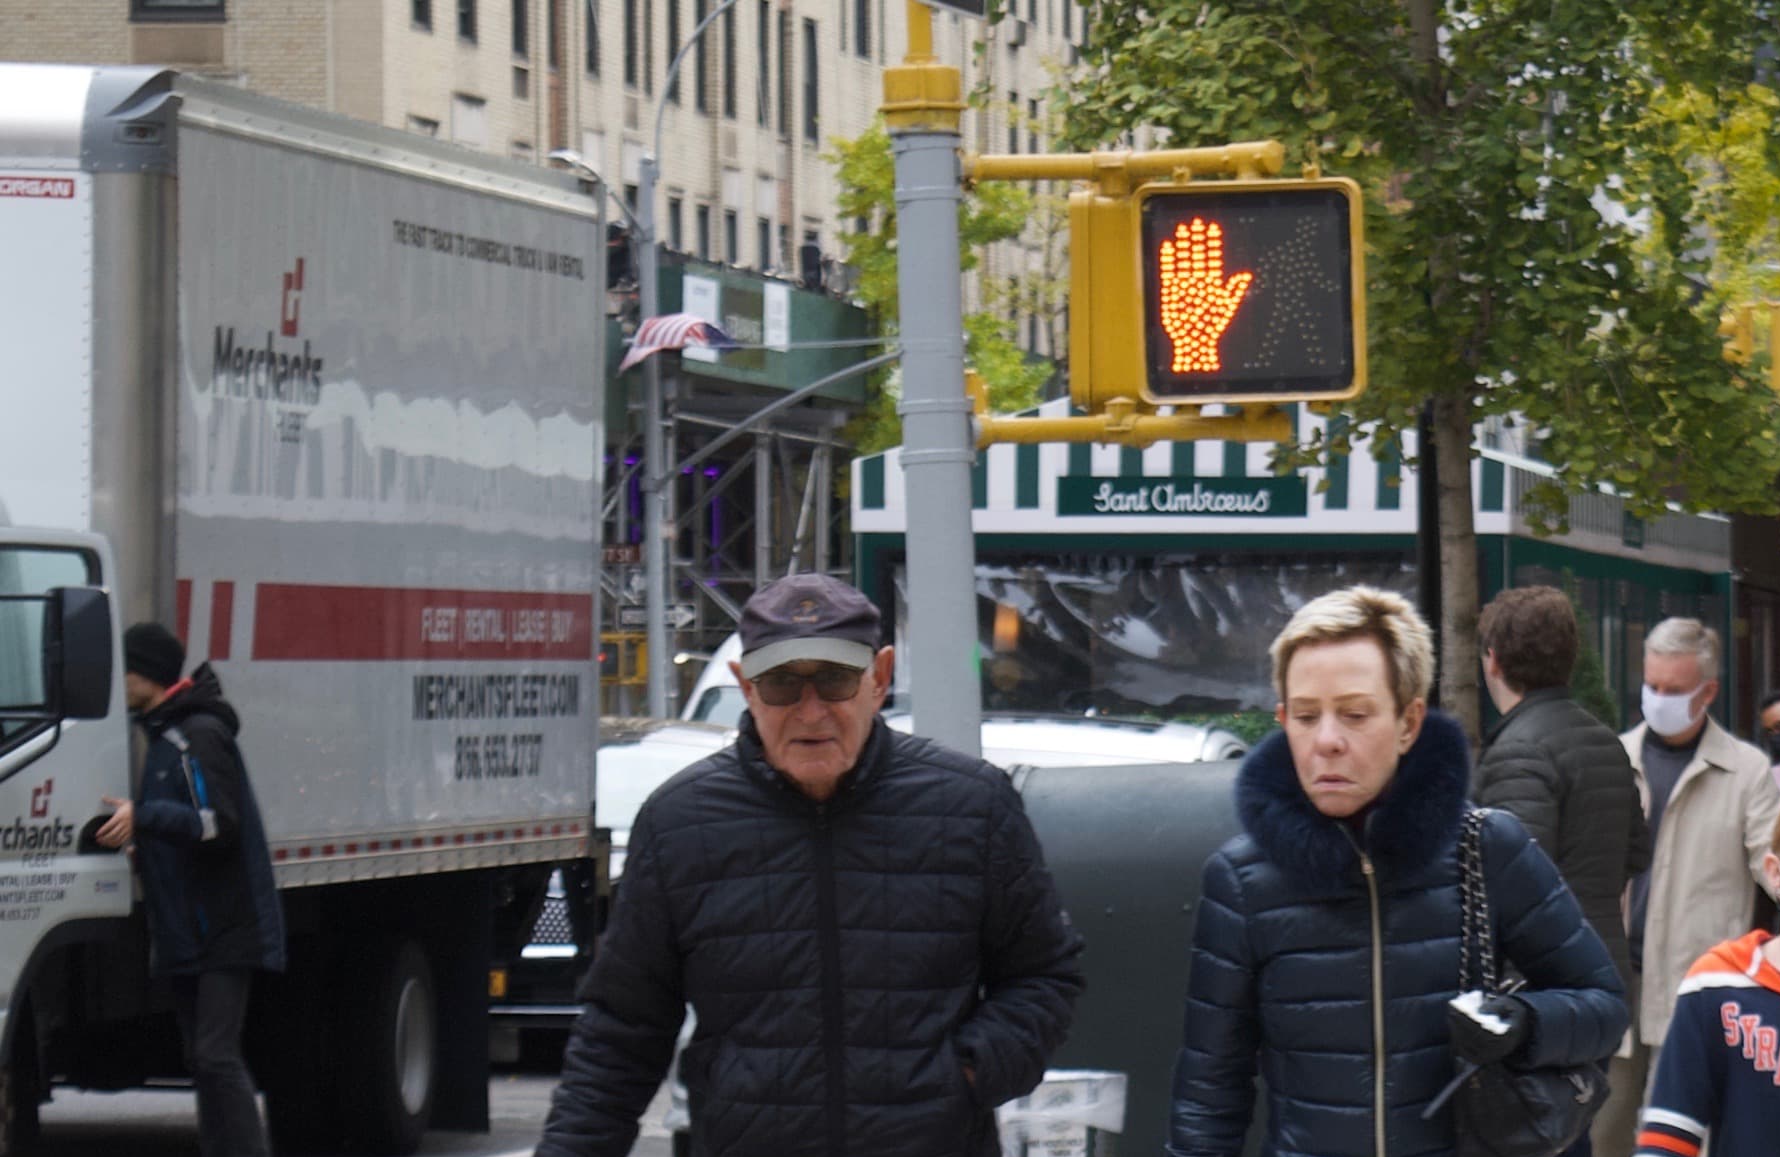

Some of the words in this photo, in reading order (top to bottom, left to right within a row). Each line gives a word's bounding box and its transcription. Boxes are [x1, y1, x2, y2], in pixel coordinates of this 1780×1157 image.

[212, 324, 325, 406] Merchants
[1093, 481, 1151, 512] Sant
[422, 608, 457, 642] FLEET
[463, 608, 506, 642] RENTAL
[512, 609, 545, 642] LEASE
[551, 610, 574, 642] BUY
[412, 674, 579, 721] MERCHANTSFLEET.COM
[0, 816, 74, 849] chants
